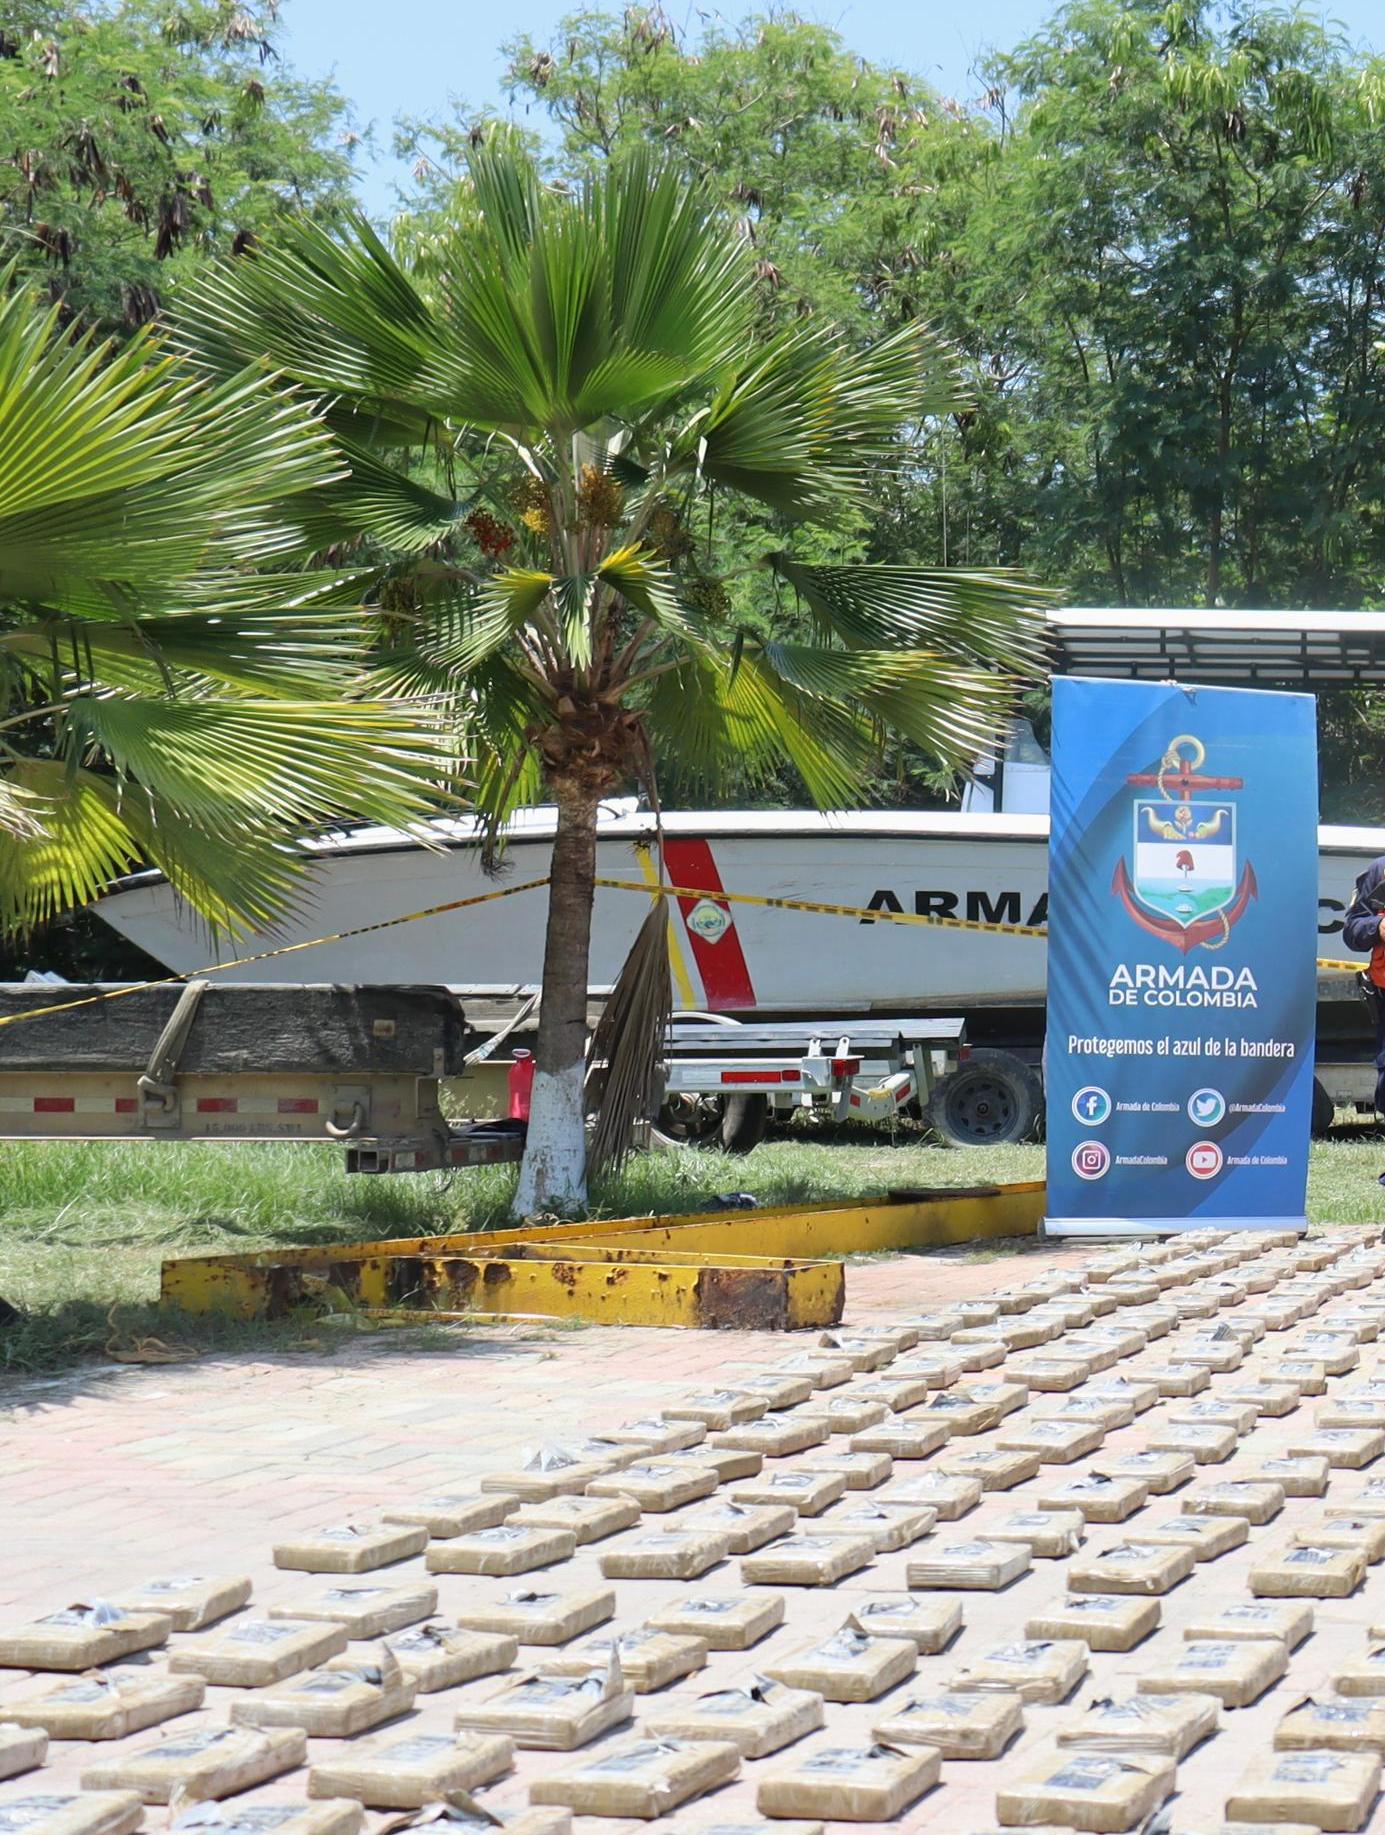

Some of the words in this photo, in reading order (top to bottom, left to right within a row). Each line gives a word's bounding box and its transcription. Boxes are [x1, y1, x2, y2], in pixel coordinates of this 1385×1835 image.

[1109, 964, 1258, 991] ARMADA
[1109, 989, 1138, 1005] DE
[1143, 990, 1258, 1008] COLOMBIA
[1068, 1035, 1153, 1057] Protegemos
[1157, 1037, 1169, 1055] el
[1173, 1037, 1201, 1057] azul
[1205, 1037, 1221, 1056] de
[1224, 1038, 1237, 1057] la
[1240, 1038, 1295, 1058] bandera
[1116, 1102, 1141, 1112] Armada
[1142, 1102, 1150, 1111] de
[1151, 1102, 1180, 1112] Colombia
[1115, 1155, 1168, 1165] ArmadaColombia
[1227, 1156, 1250, 1165] Armada
[1251, 1156, 1259, 1165] de
[1260, 1156, 1288, 1165] Colombia
